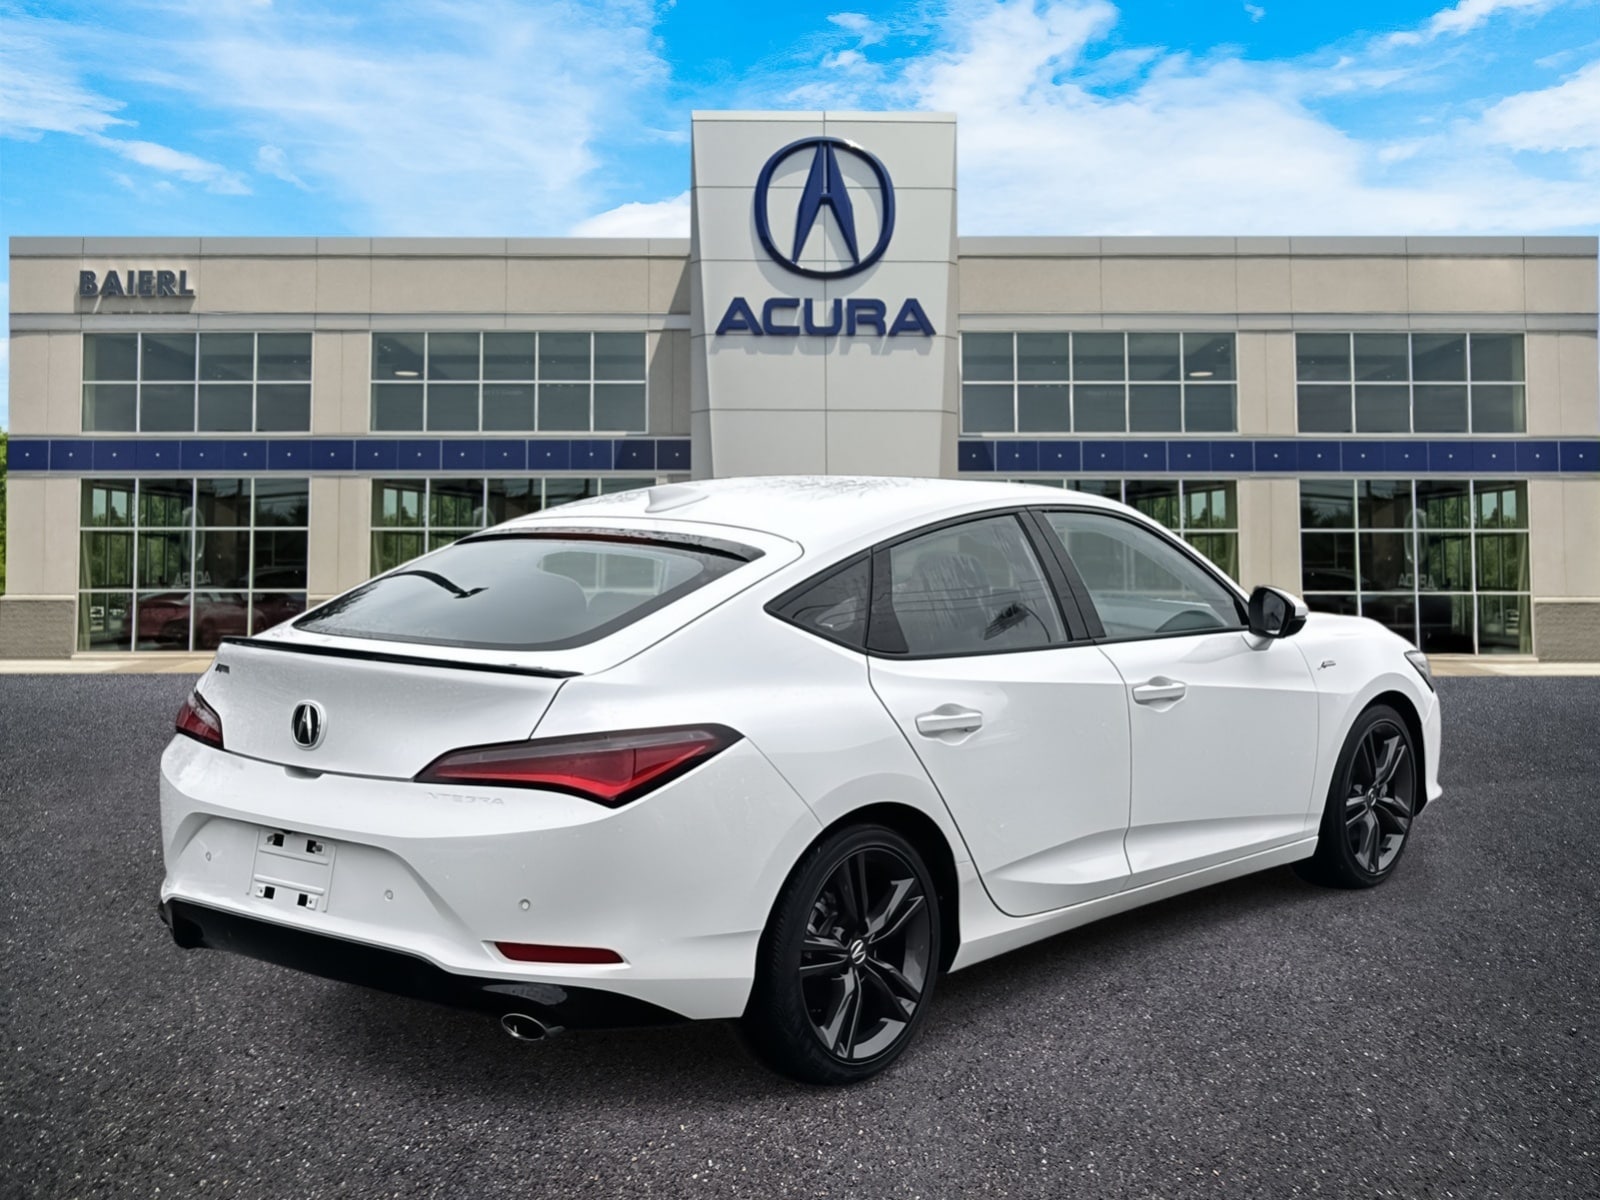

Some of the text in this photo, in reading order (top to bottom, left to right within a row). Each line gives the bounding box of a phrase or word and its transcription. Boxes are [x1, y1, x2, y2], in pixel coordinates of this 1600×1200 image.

[79, 269, 195, 297] BAIERL
[715, 297, 937, 337] ACURA
[1398, 573, 1436, 589] ACRA
